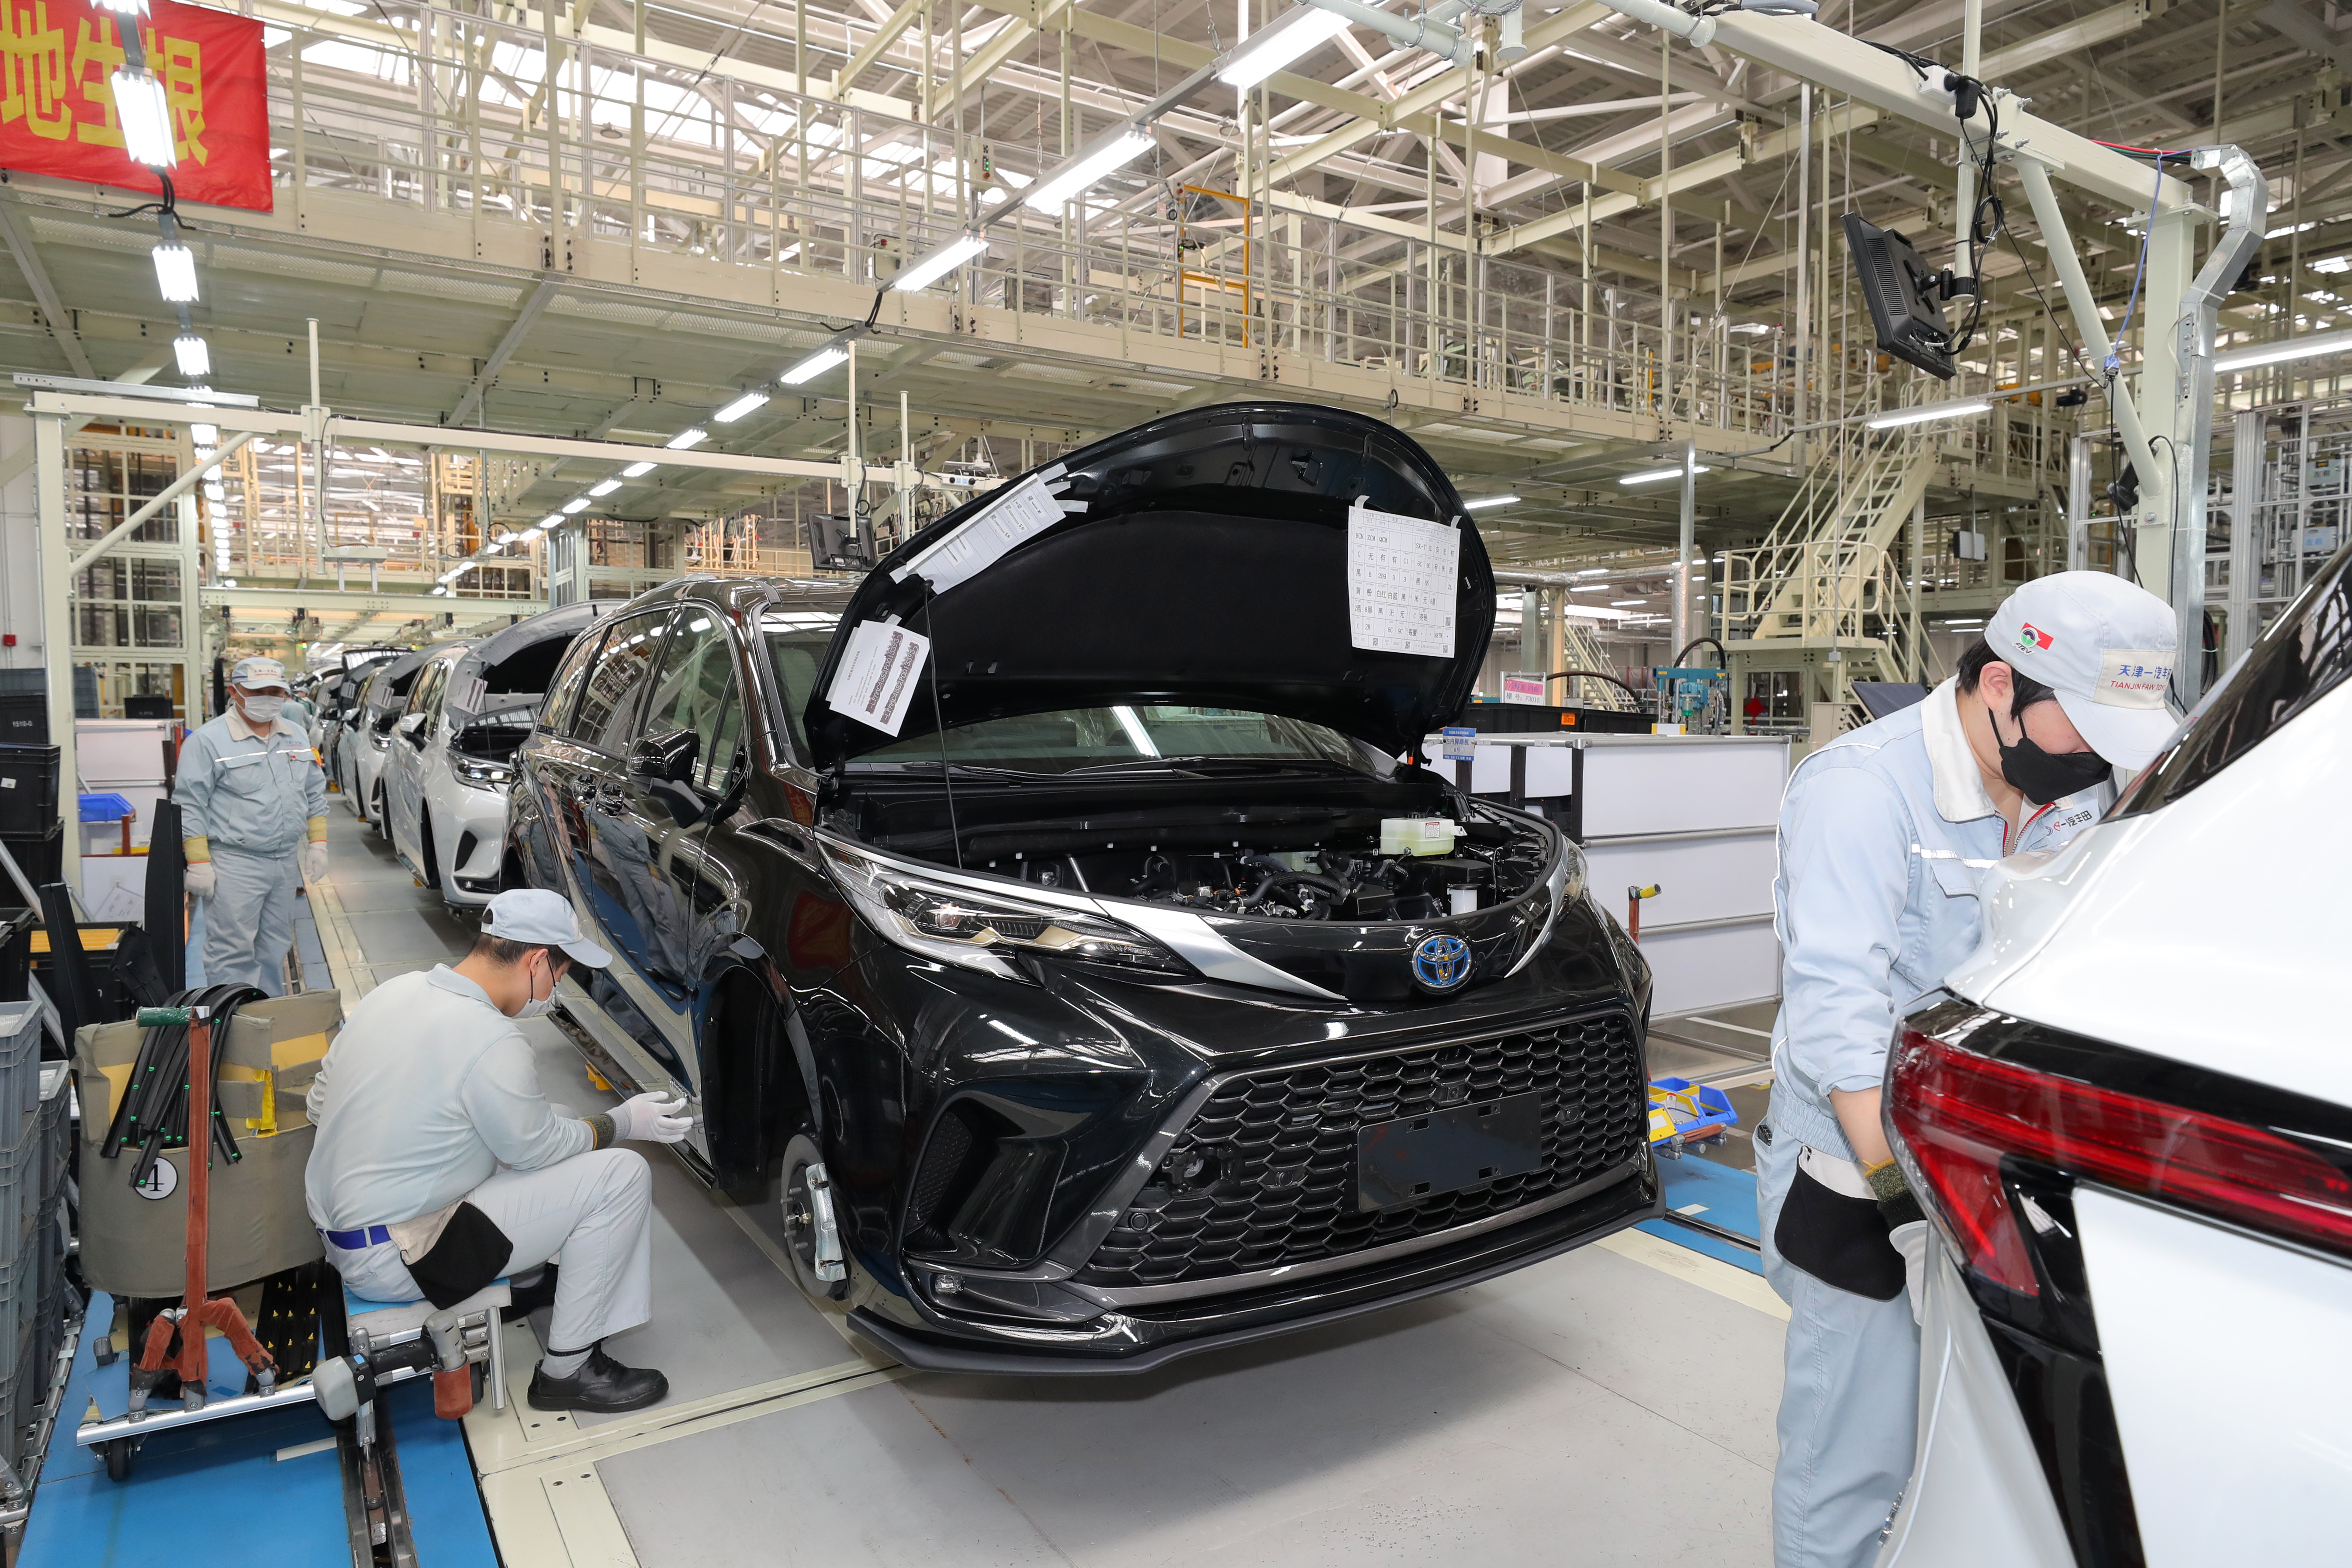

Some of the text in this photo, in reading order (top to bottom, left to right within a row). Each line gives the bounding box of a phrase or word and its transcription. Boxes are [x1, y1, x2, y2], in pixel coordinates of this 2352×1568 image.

[1392, 556, 1397, 564] 有
[1367, 588, 1372, 596] 粉
[1377, 590, 1386, 598] 白红
[1388, 591, 1397, 600] 白蓝
[2110, 680, 2141, 690] TIANJIN
[2061, 810, 2093, 827] 一汽丰田
